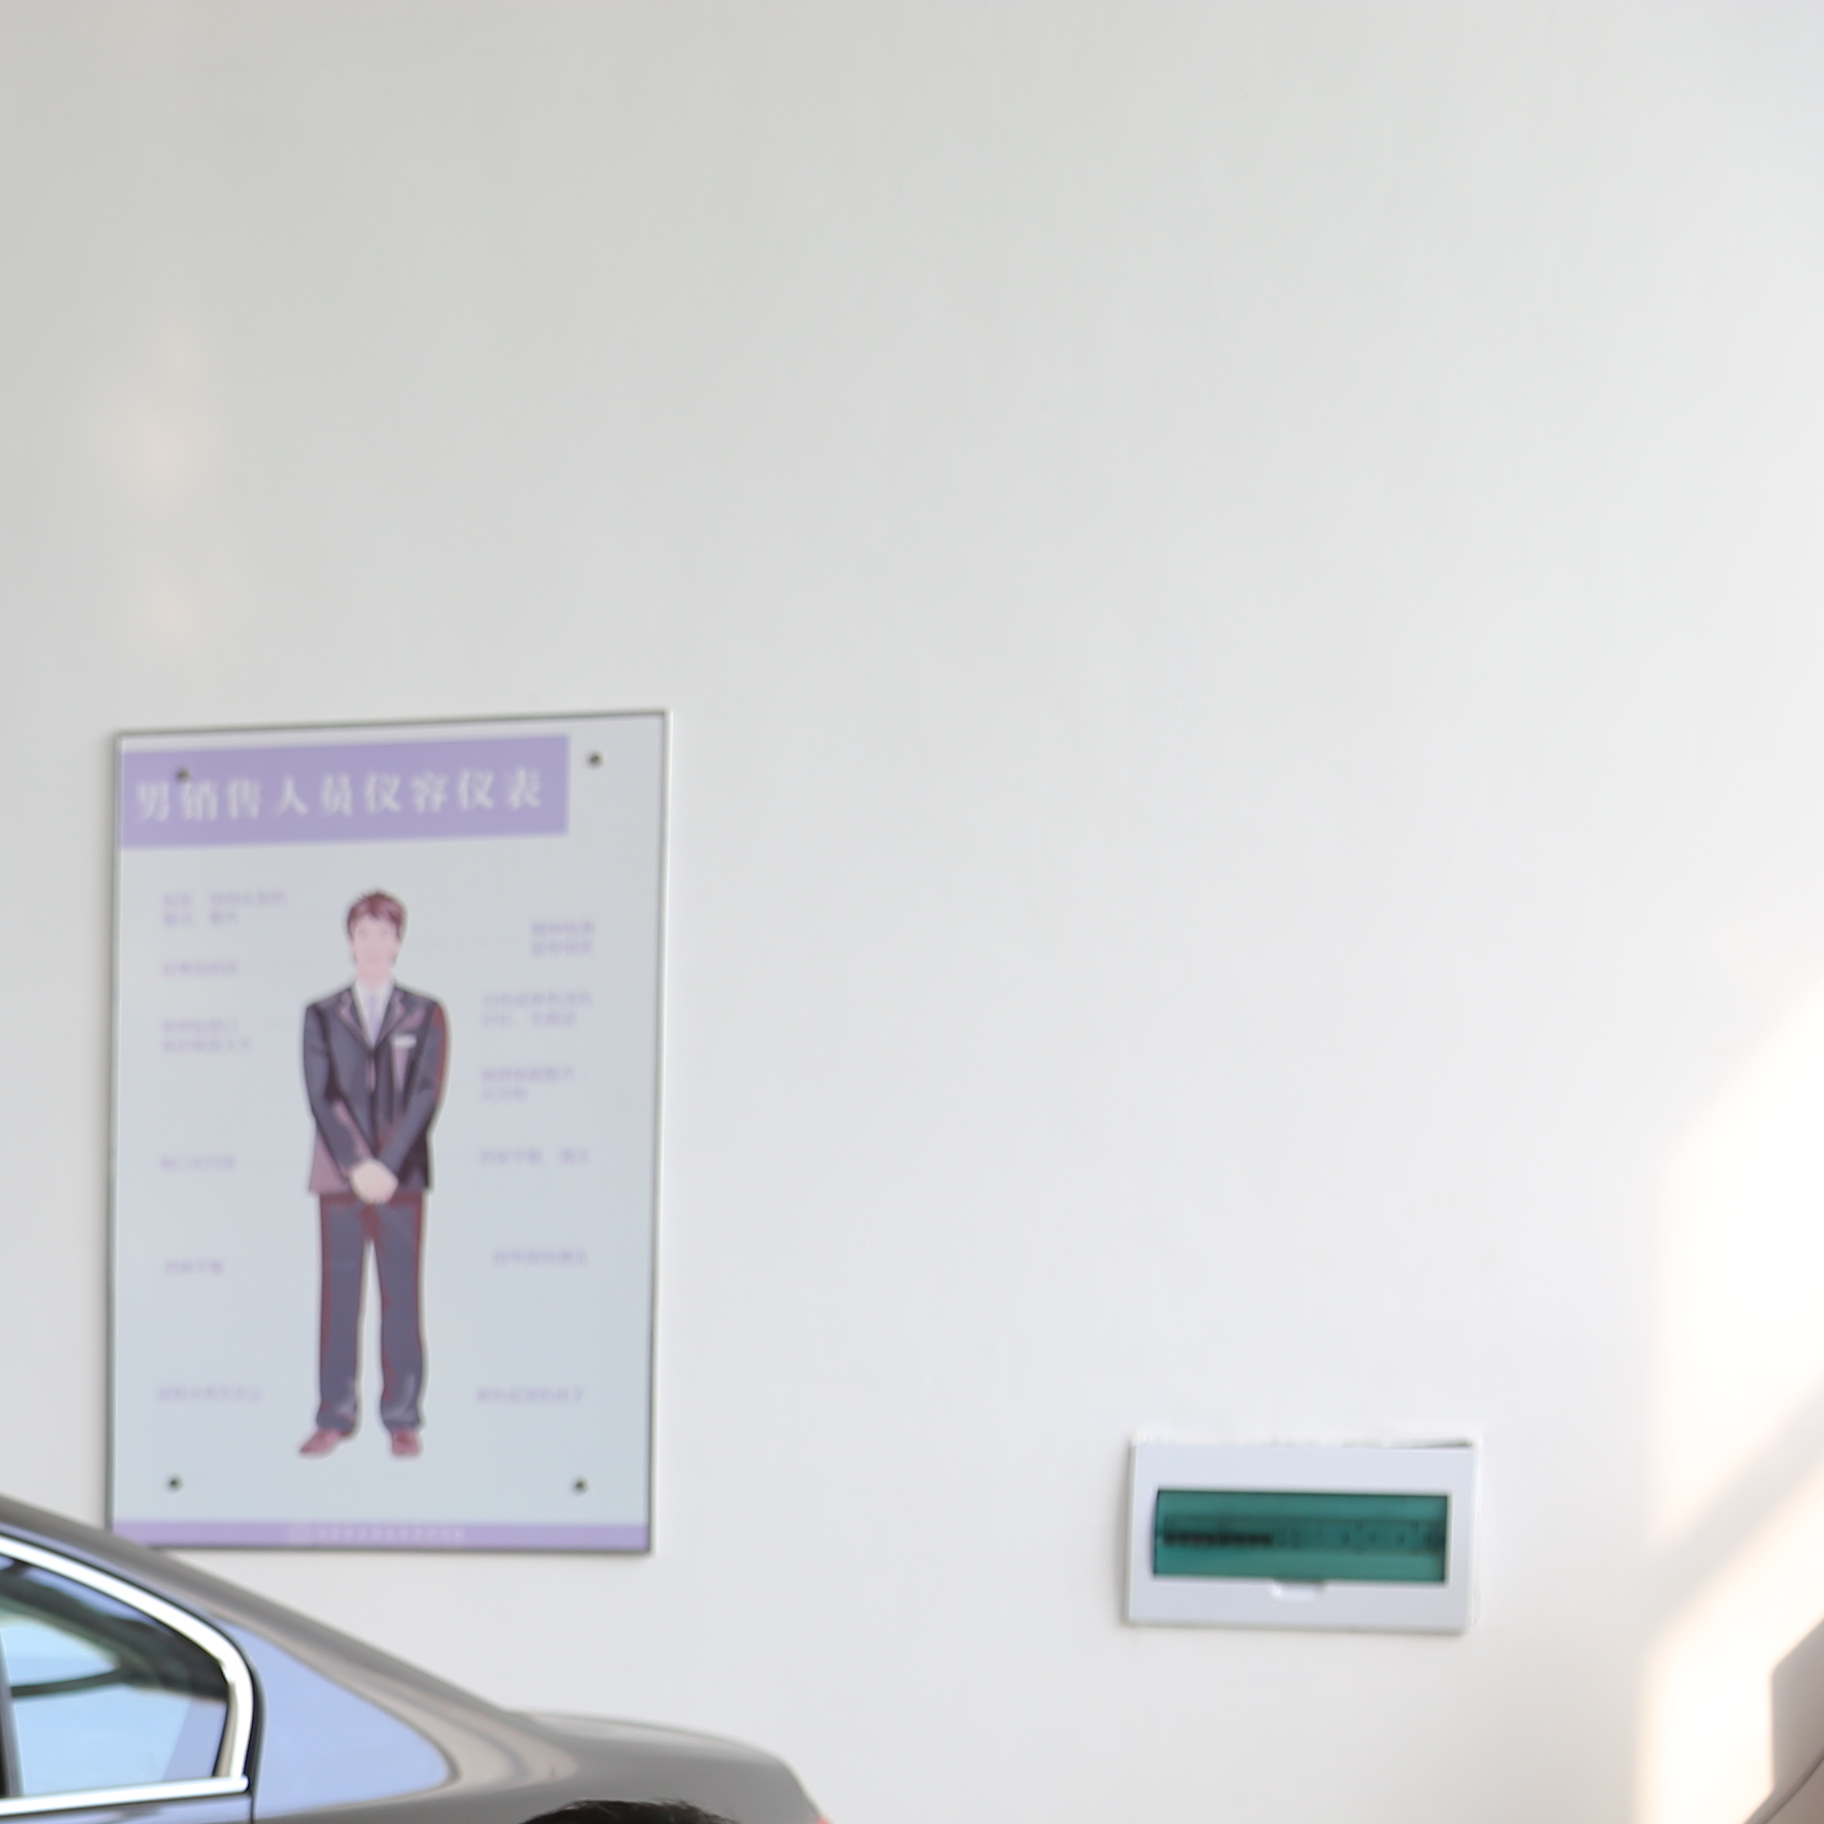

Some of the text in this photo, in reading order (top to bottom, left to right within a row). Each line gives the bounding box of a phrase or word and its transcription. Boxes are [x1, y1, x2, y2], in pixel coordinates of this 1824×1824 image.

[136, 767, 544, 823] 男销售人员仪容仪表
